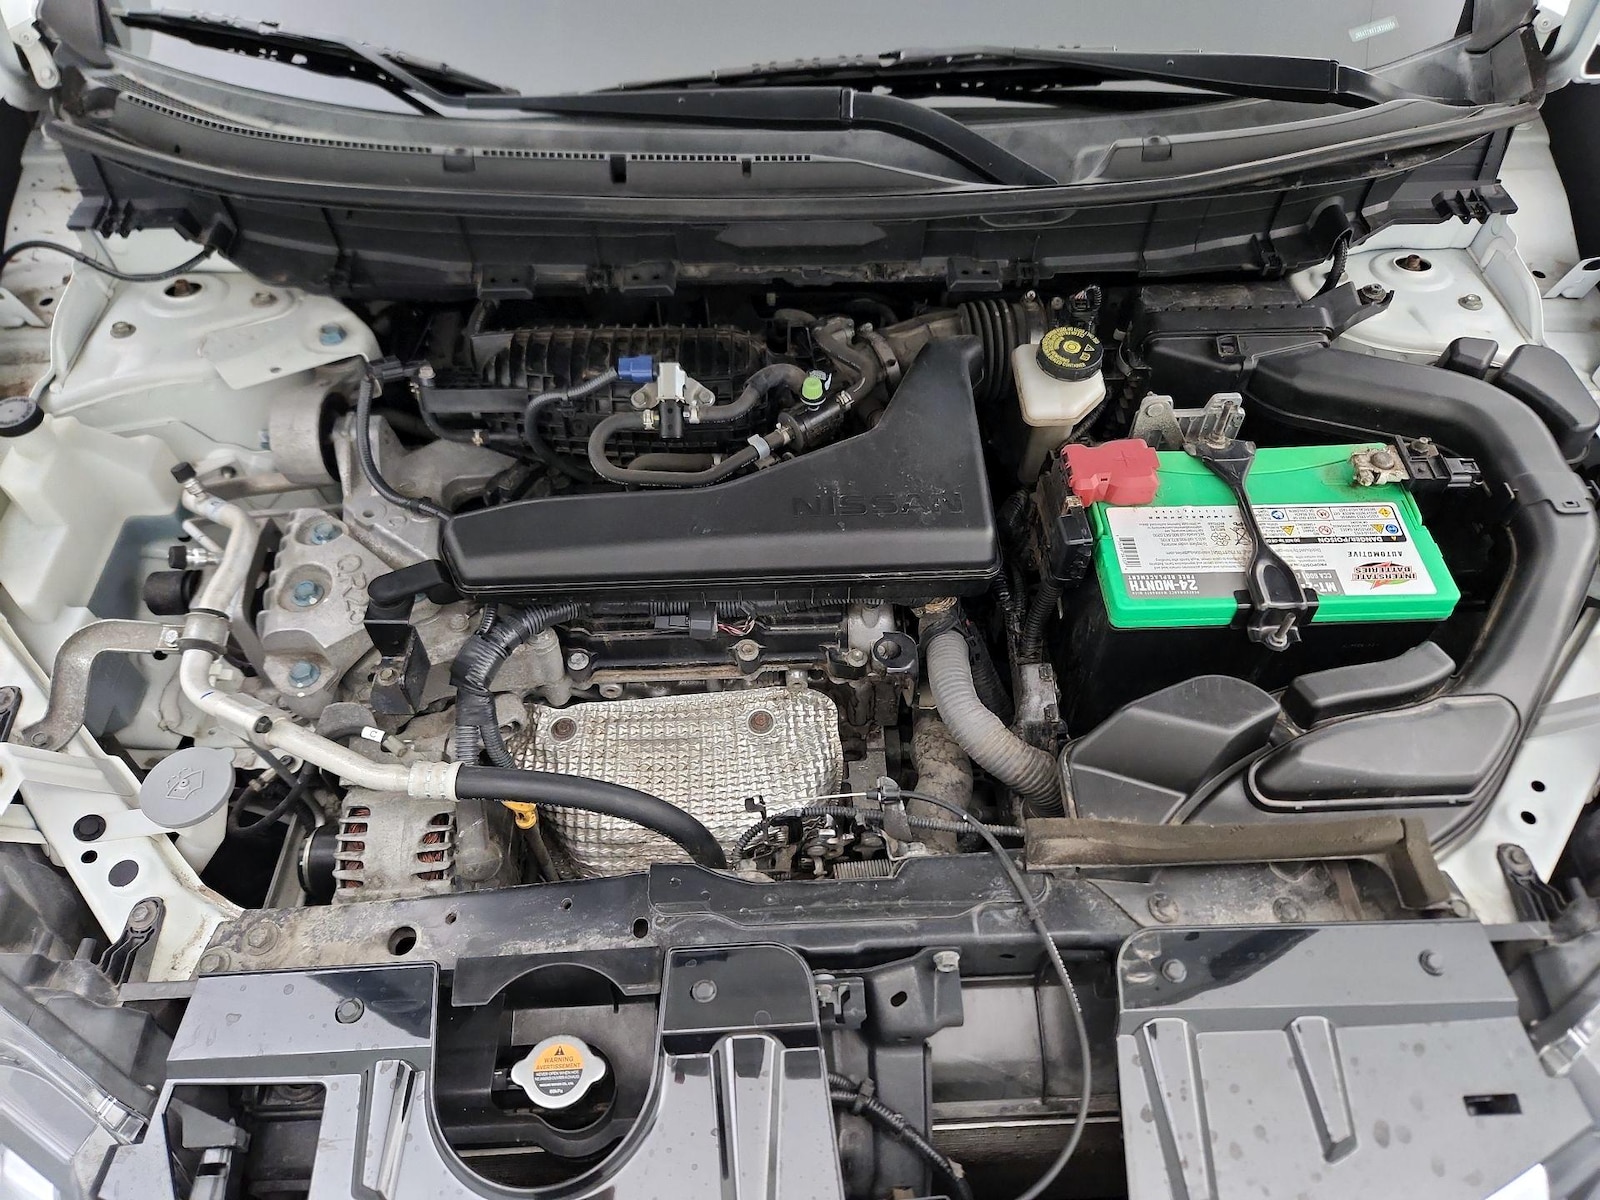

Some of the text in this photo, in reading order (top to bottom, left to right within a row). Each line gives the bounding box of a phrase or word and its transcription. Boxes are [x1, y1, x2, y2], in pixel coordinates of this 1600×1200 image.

[792, 492, 963, 517] NISSAN
[1354, 566, 1411, 574] BATTERIES
[1353, 572, 1416, 580] INTERSTATE
[1129, 580, 1198, 591] 24-MONTH
[370, 730, 377, 738] C
